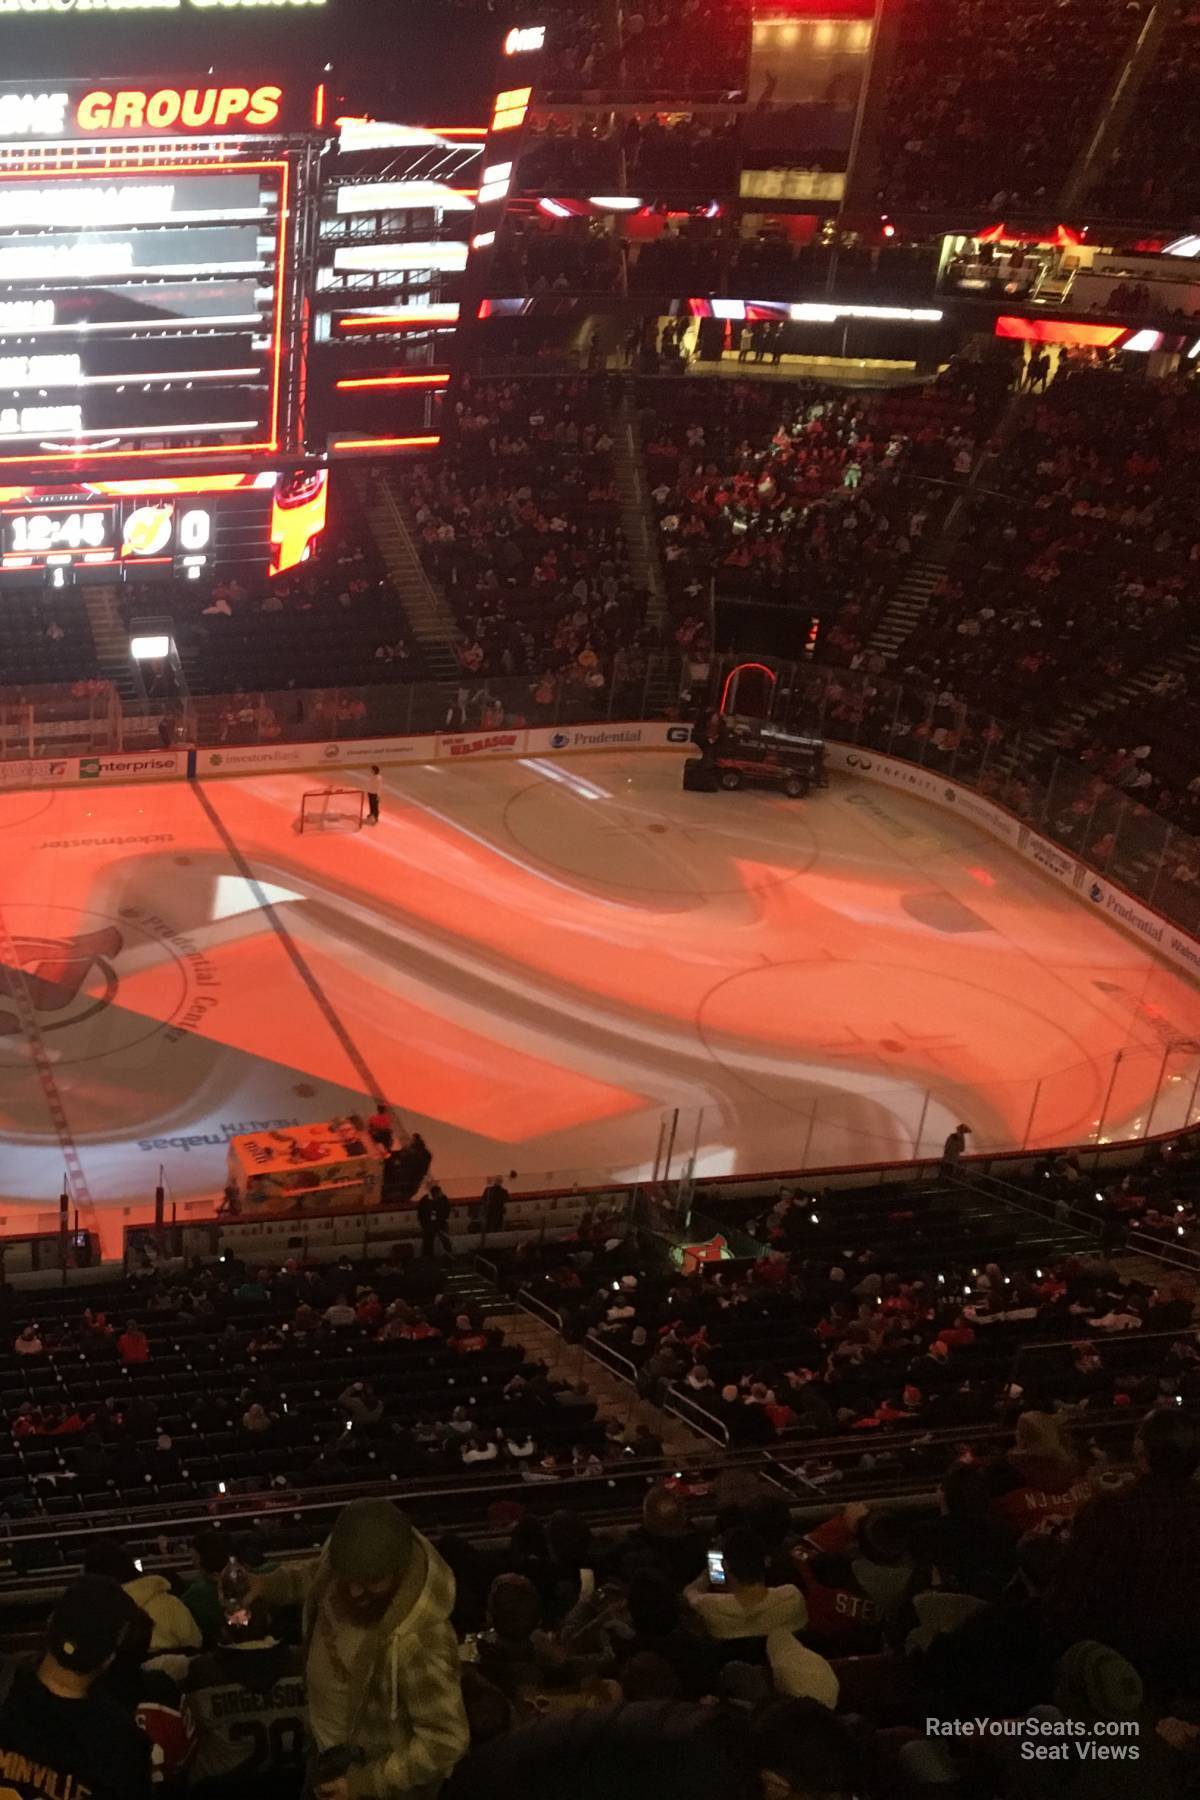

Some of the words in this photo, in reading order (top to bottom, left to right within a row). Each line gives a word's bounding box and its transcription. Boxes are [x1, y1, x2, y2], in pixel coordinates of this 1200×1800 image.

[77, 86, 283, 132] GROUPS
[180, 509, 210, 550] 0
[574, 729, 642, 745] Prudential
[876, 764, 937, 793] INFINITI
[1105, 893, 1164, 943] Prudential
[141, 916, 222, 987] Prudential
[163, 996, 220, 1044] Center
